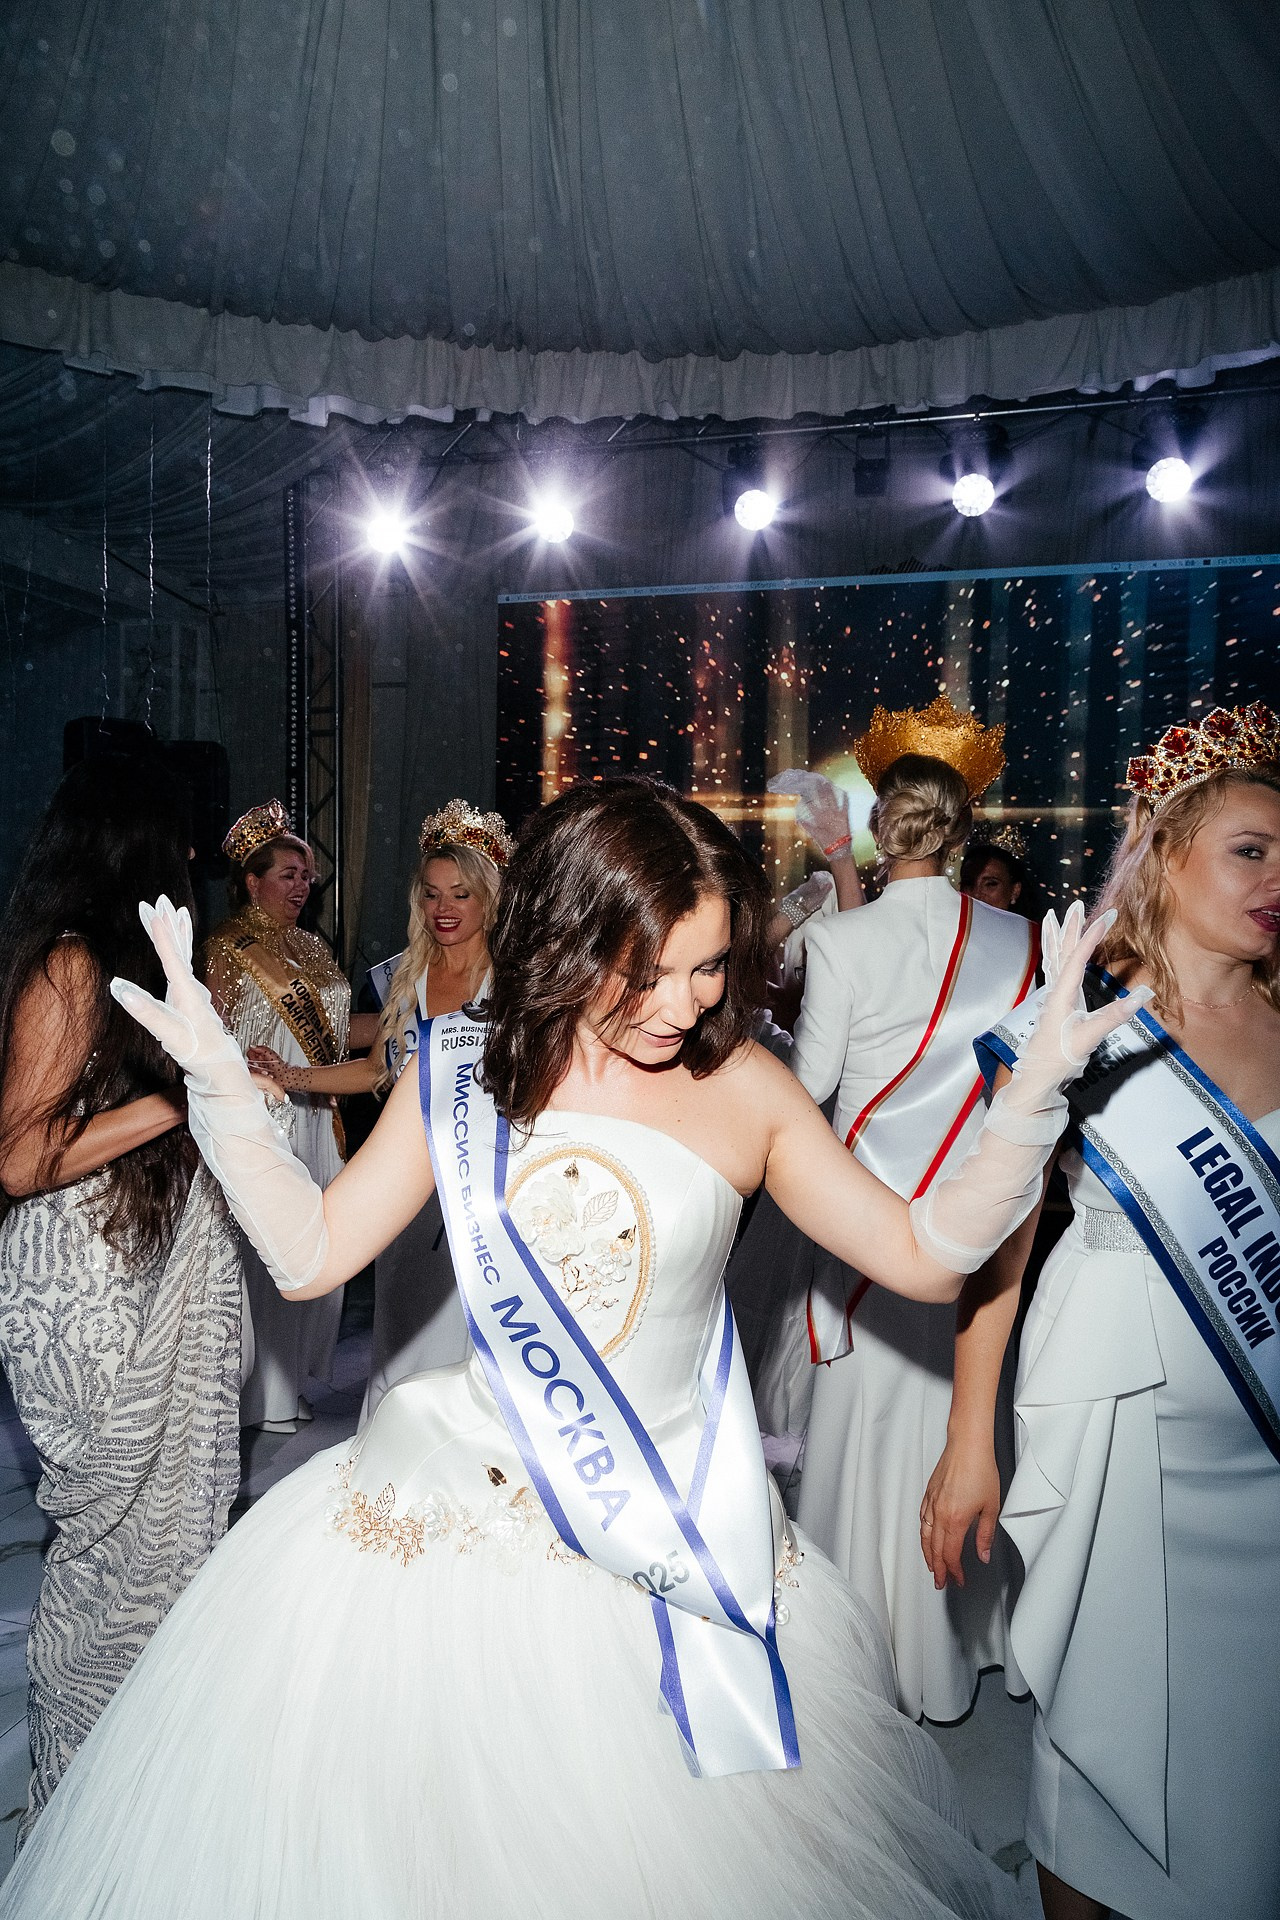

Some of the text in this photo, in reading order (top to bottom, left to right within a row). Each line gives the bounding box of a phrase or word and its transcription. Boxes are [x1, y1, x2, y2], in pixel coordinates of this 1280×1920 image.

[290, 978, 324, 1037] КОРОЛЕВА
[441, 1026, 459, 1035] MRS.
[1176, 1126, 1265, 1240] LEGAL
[453, 1063, 632, 1532] МИССИС БИЗНЕС МОСКВА
[1198, 1235, 1276, 1350] РОССИИ
[632, 1549, 690, 1594] 025
